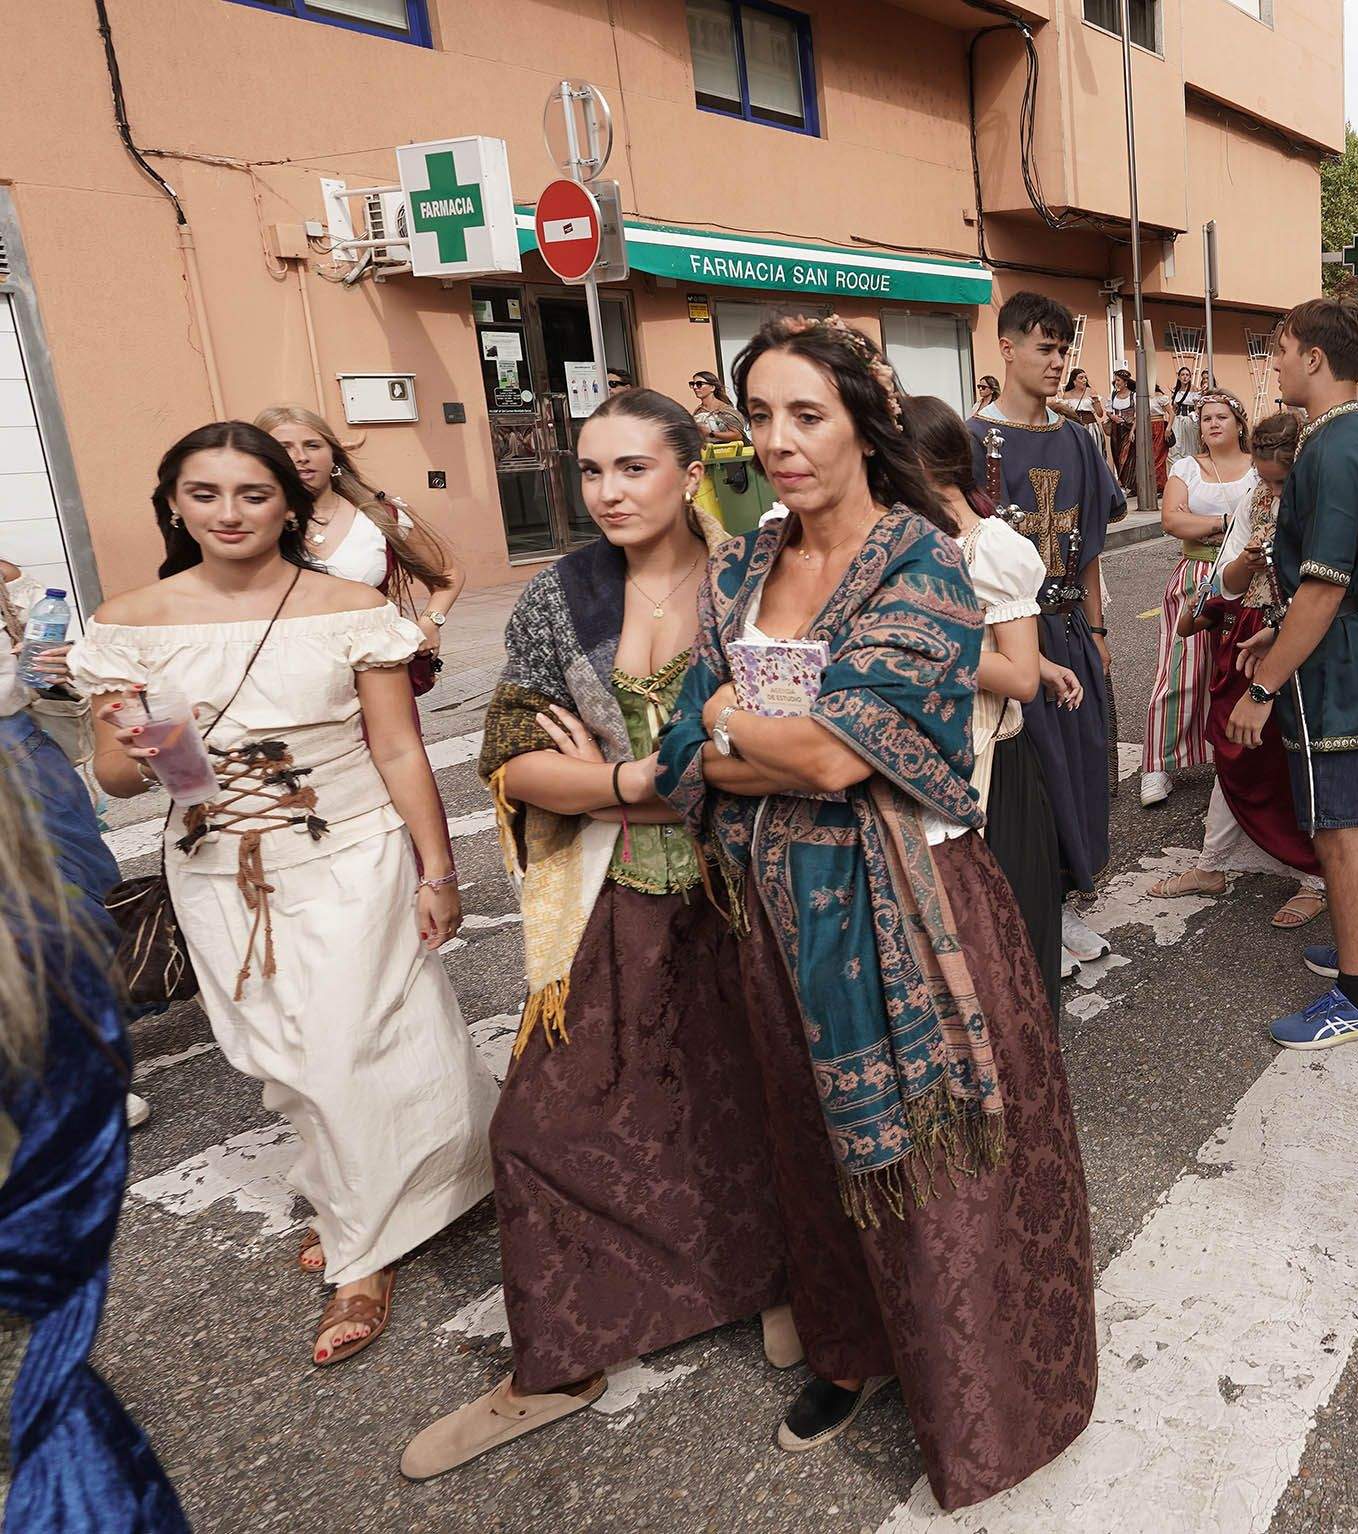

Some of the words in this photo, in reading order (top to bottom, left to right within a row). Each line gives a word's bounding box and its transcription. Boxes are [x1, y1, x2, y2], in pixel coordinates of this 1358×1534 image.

[420, 197, 474, 218] FARMACIA
[689, 255, 786, 283] FARMACIA
[792, 265, 828, 287] SAN
[835, 270, 891, 292] ROQUE
